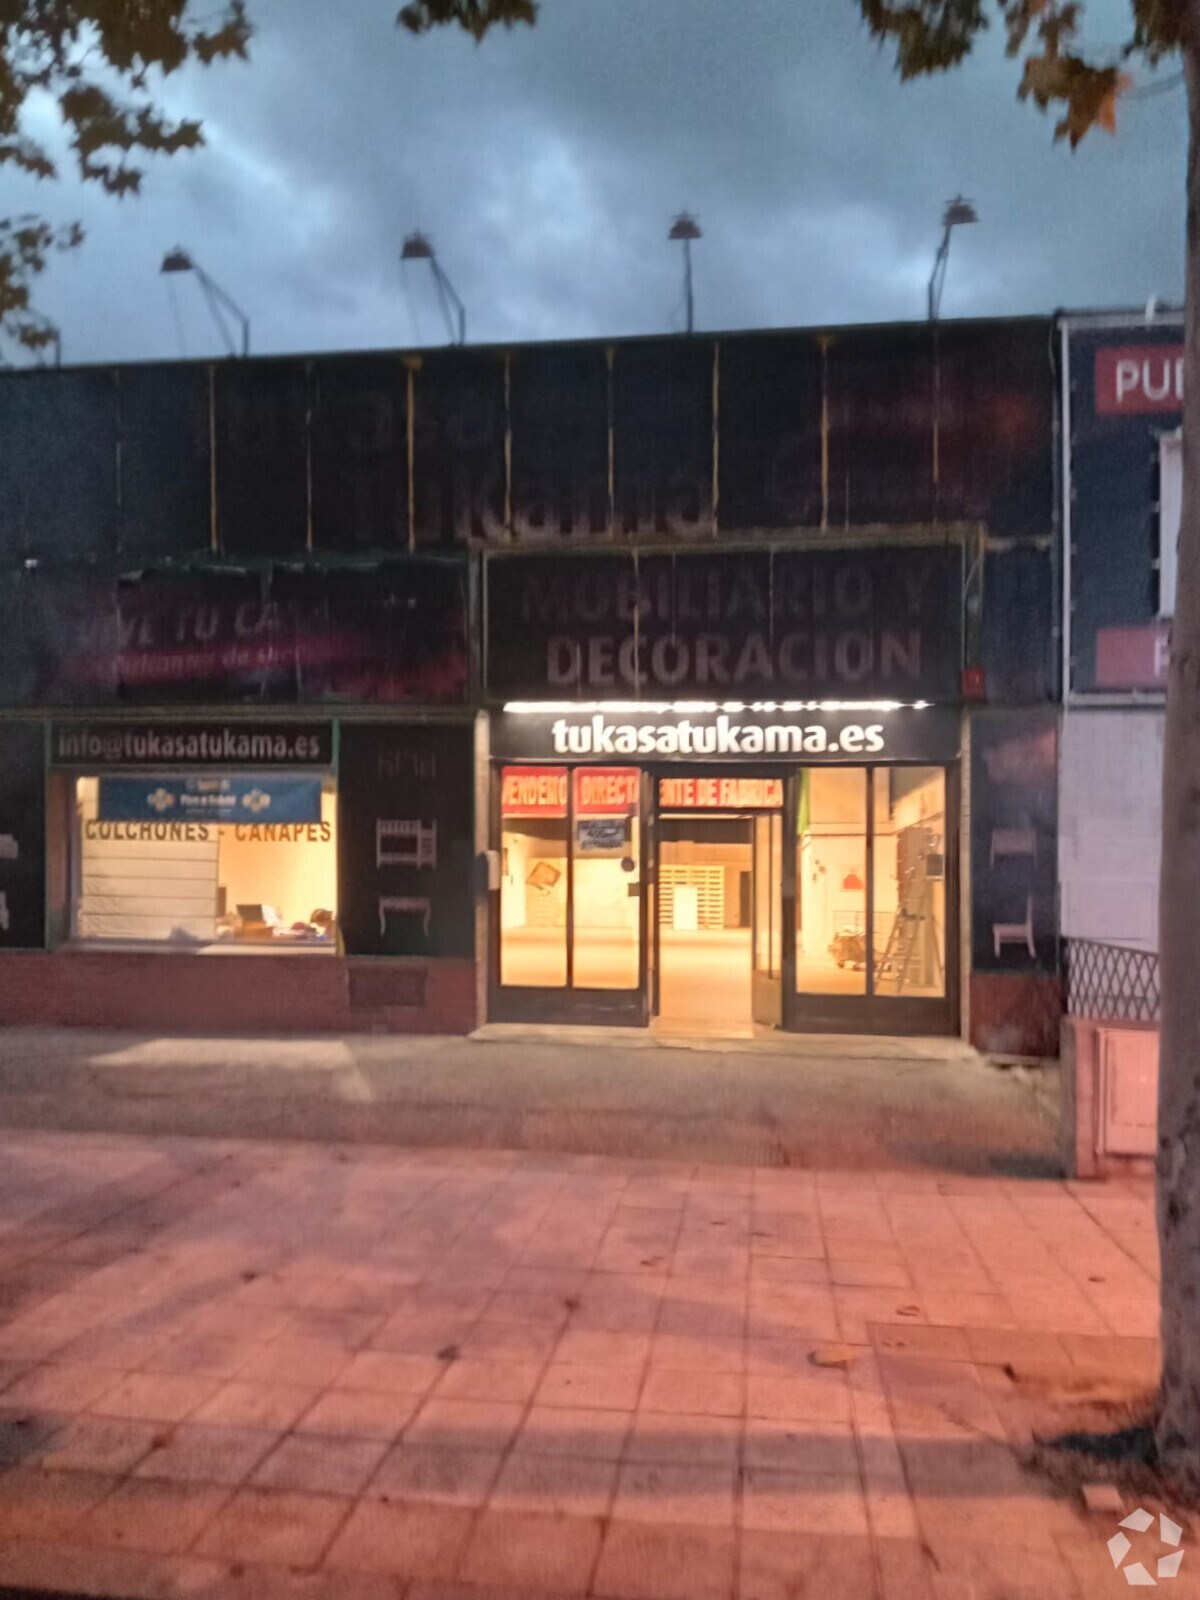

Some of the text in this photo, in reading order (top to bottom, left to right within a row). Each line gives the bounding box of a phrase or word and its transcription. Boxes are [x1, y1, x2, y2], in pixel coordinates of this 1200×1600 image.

[520, 562, 875, 624] MOBILIARIO
[546, 629, 923, 685] DECORACION
[57, 728, 320, 759] info@tukasatukama.es
[551, 714, 885, 754] tukasatukama.es
[697, 778, 718, 807] DE
[84, 819, 210, 841] COLCHONES
